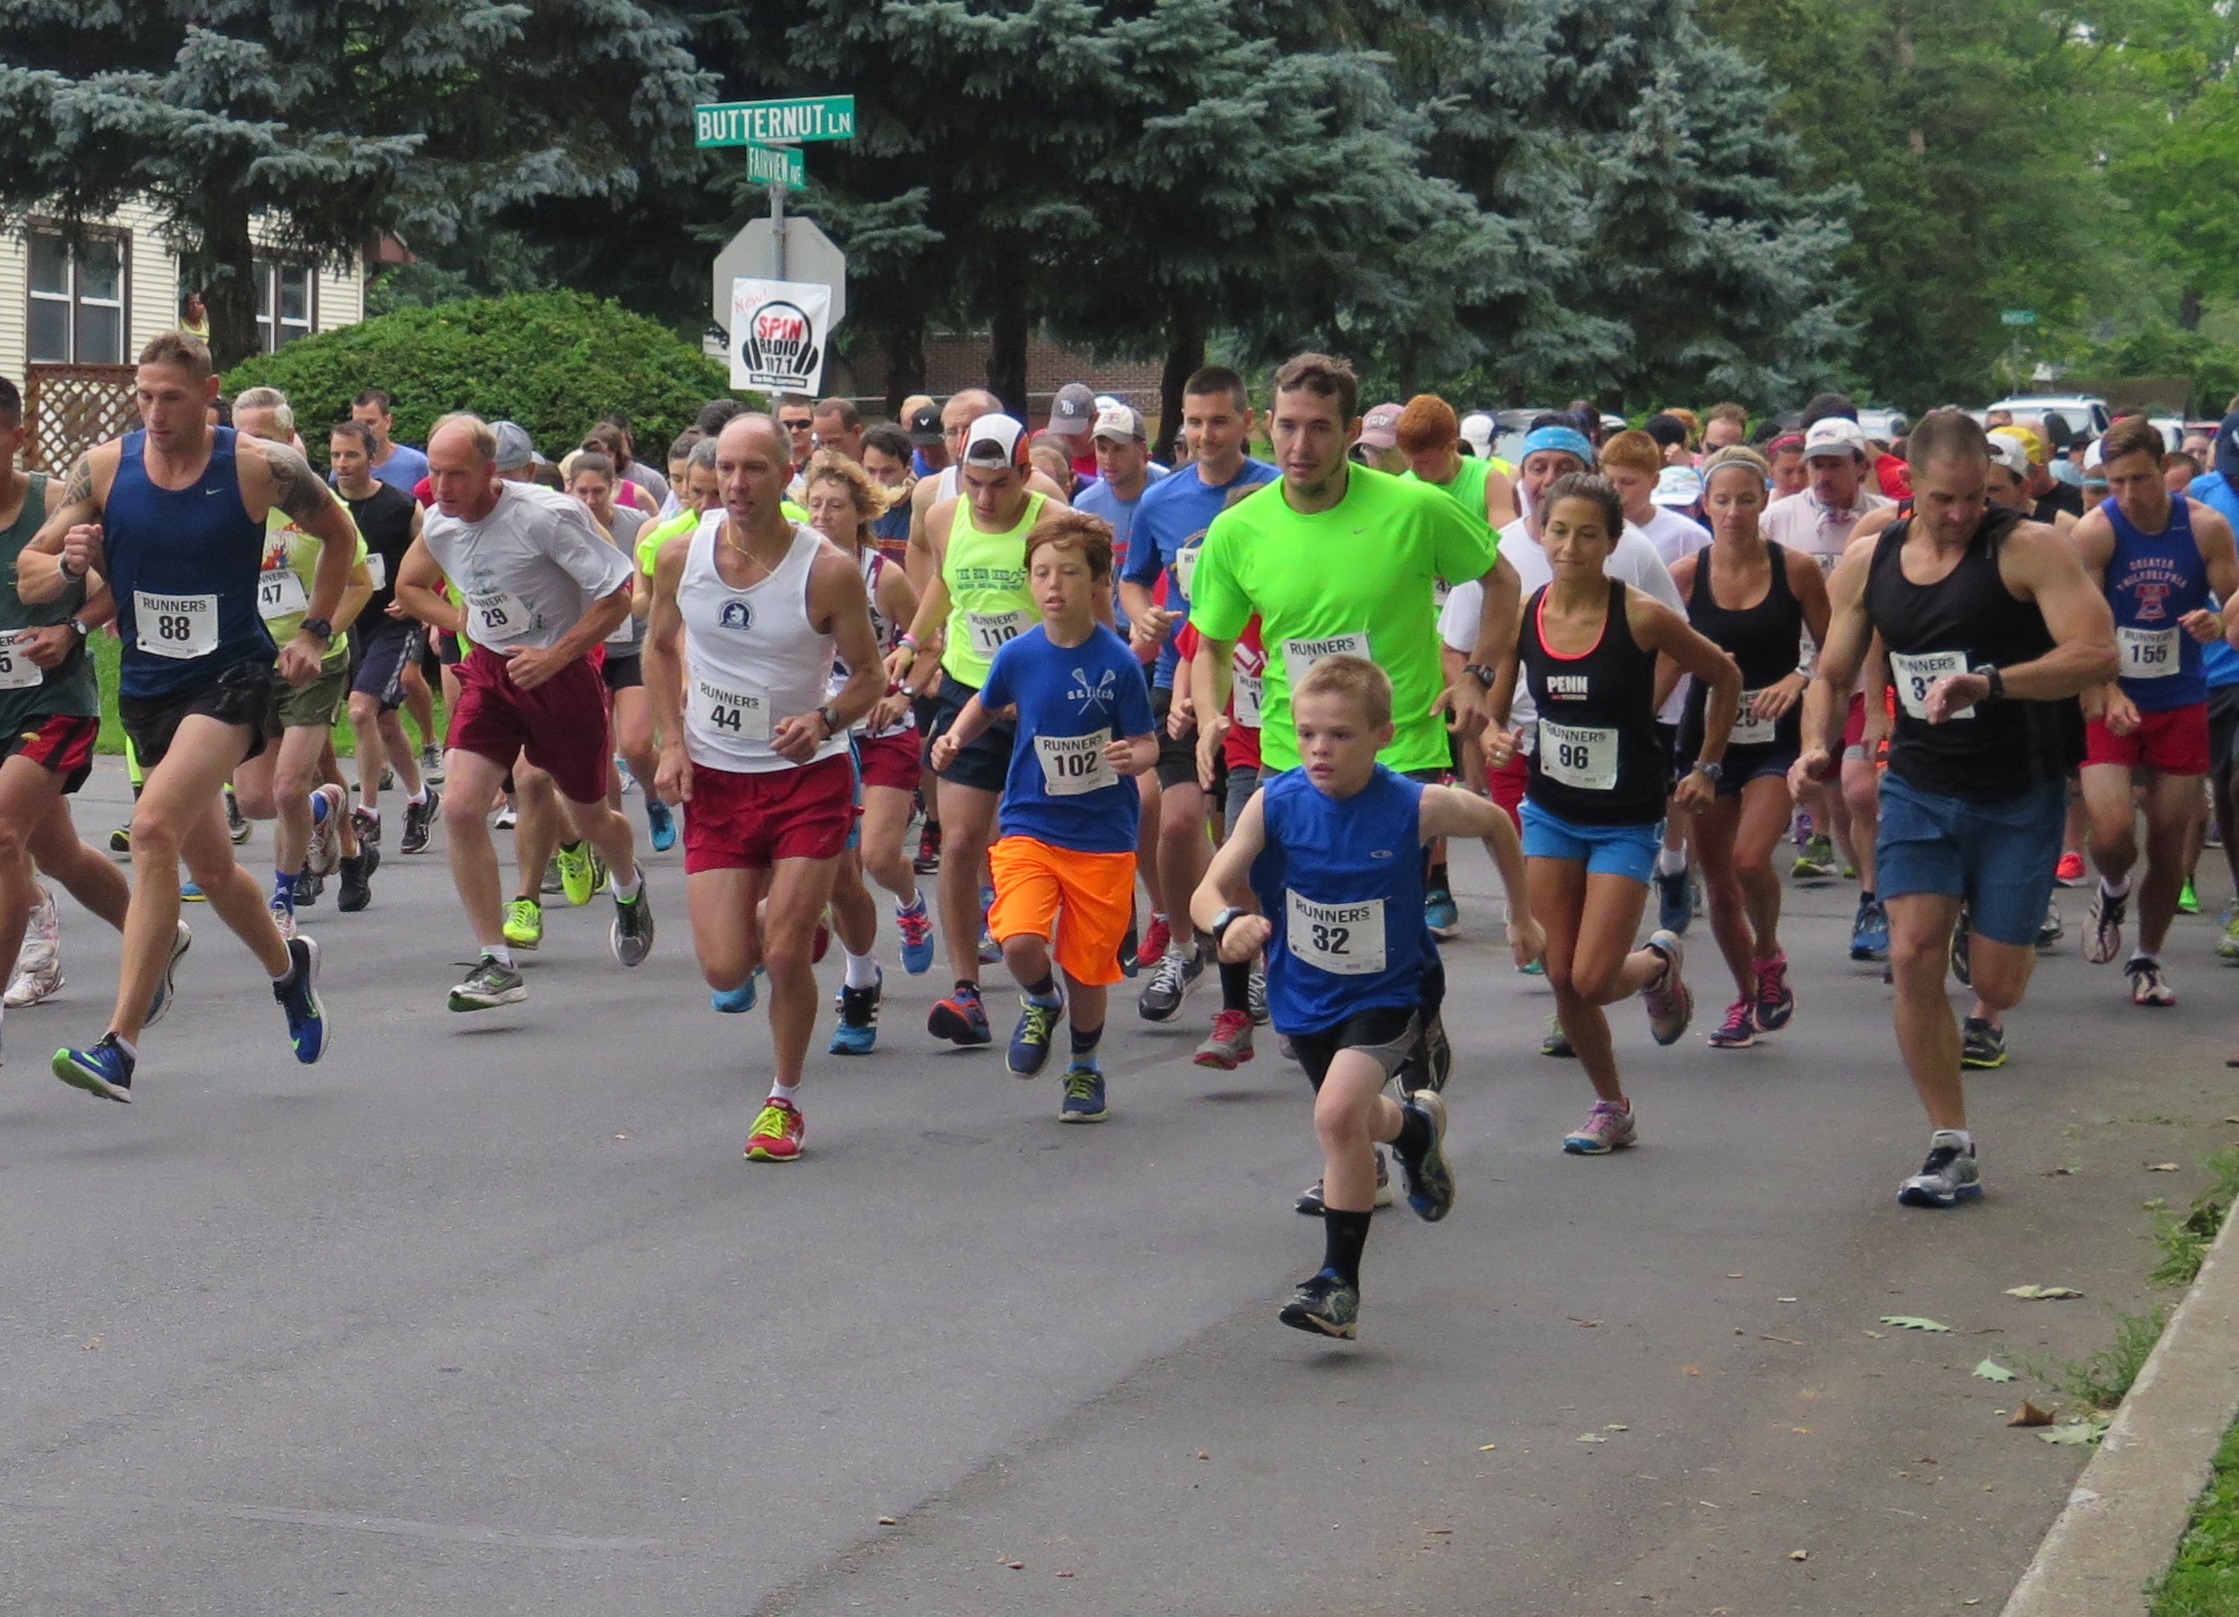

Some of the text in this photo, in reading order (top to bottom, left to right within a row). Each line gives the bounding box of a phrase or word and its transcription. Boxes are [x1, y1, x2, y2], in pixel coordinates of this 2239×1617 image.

[698, 104, 850, 142] BUTTERNUT LN
[750, 147, 788, 183] FAIRVIEW
[758, 316, 803, 341] SPIN
[759, 338, 800, 357] RADIO
[2129, 558, 2175, 571] GREATER
[261, 584, 282, 605] 47
[158, 615, 191, 641] 88
[481, 608, 508, 628] 29
[2131, 644, 2168, 664] 155
[1546, 676, 1588, 693] PENN
[1911, 675, 1937, 702] 3
[710, 704, 742, 732] 44
[1053, 750, 1098, 777] 102
[1559, 743, 1588, 769] 96
[1312, 924, 1350, 955] 32
